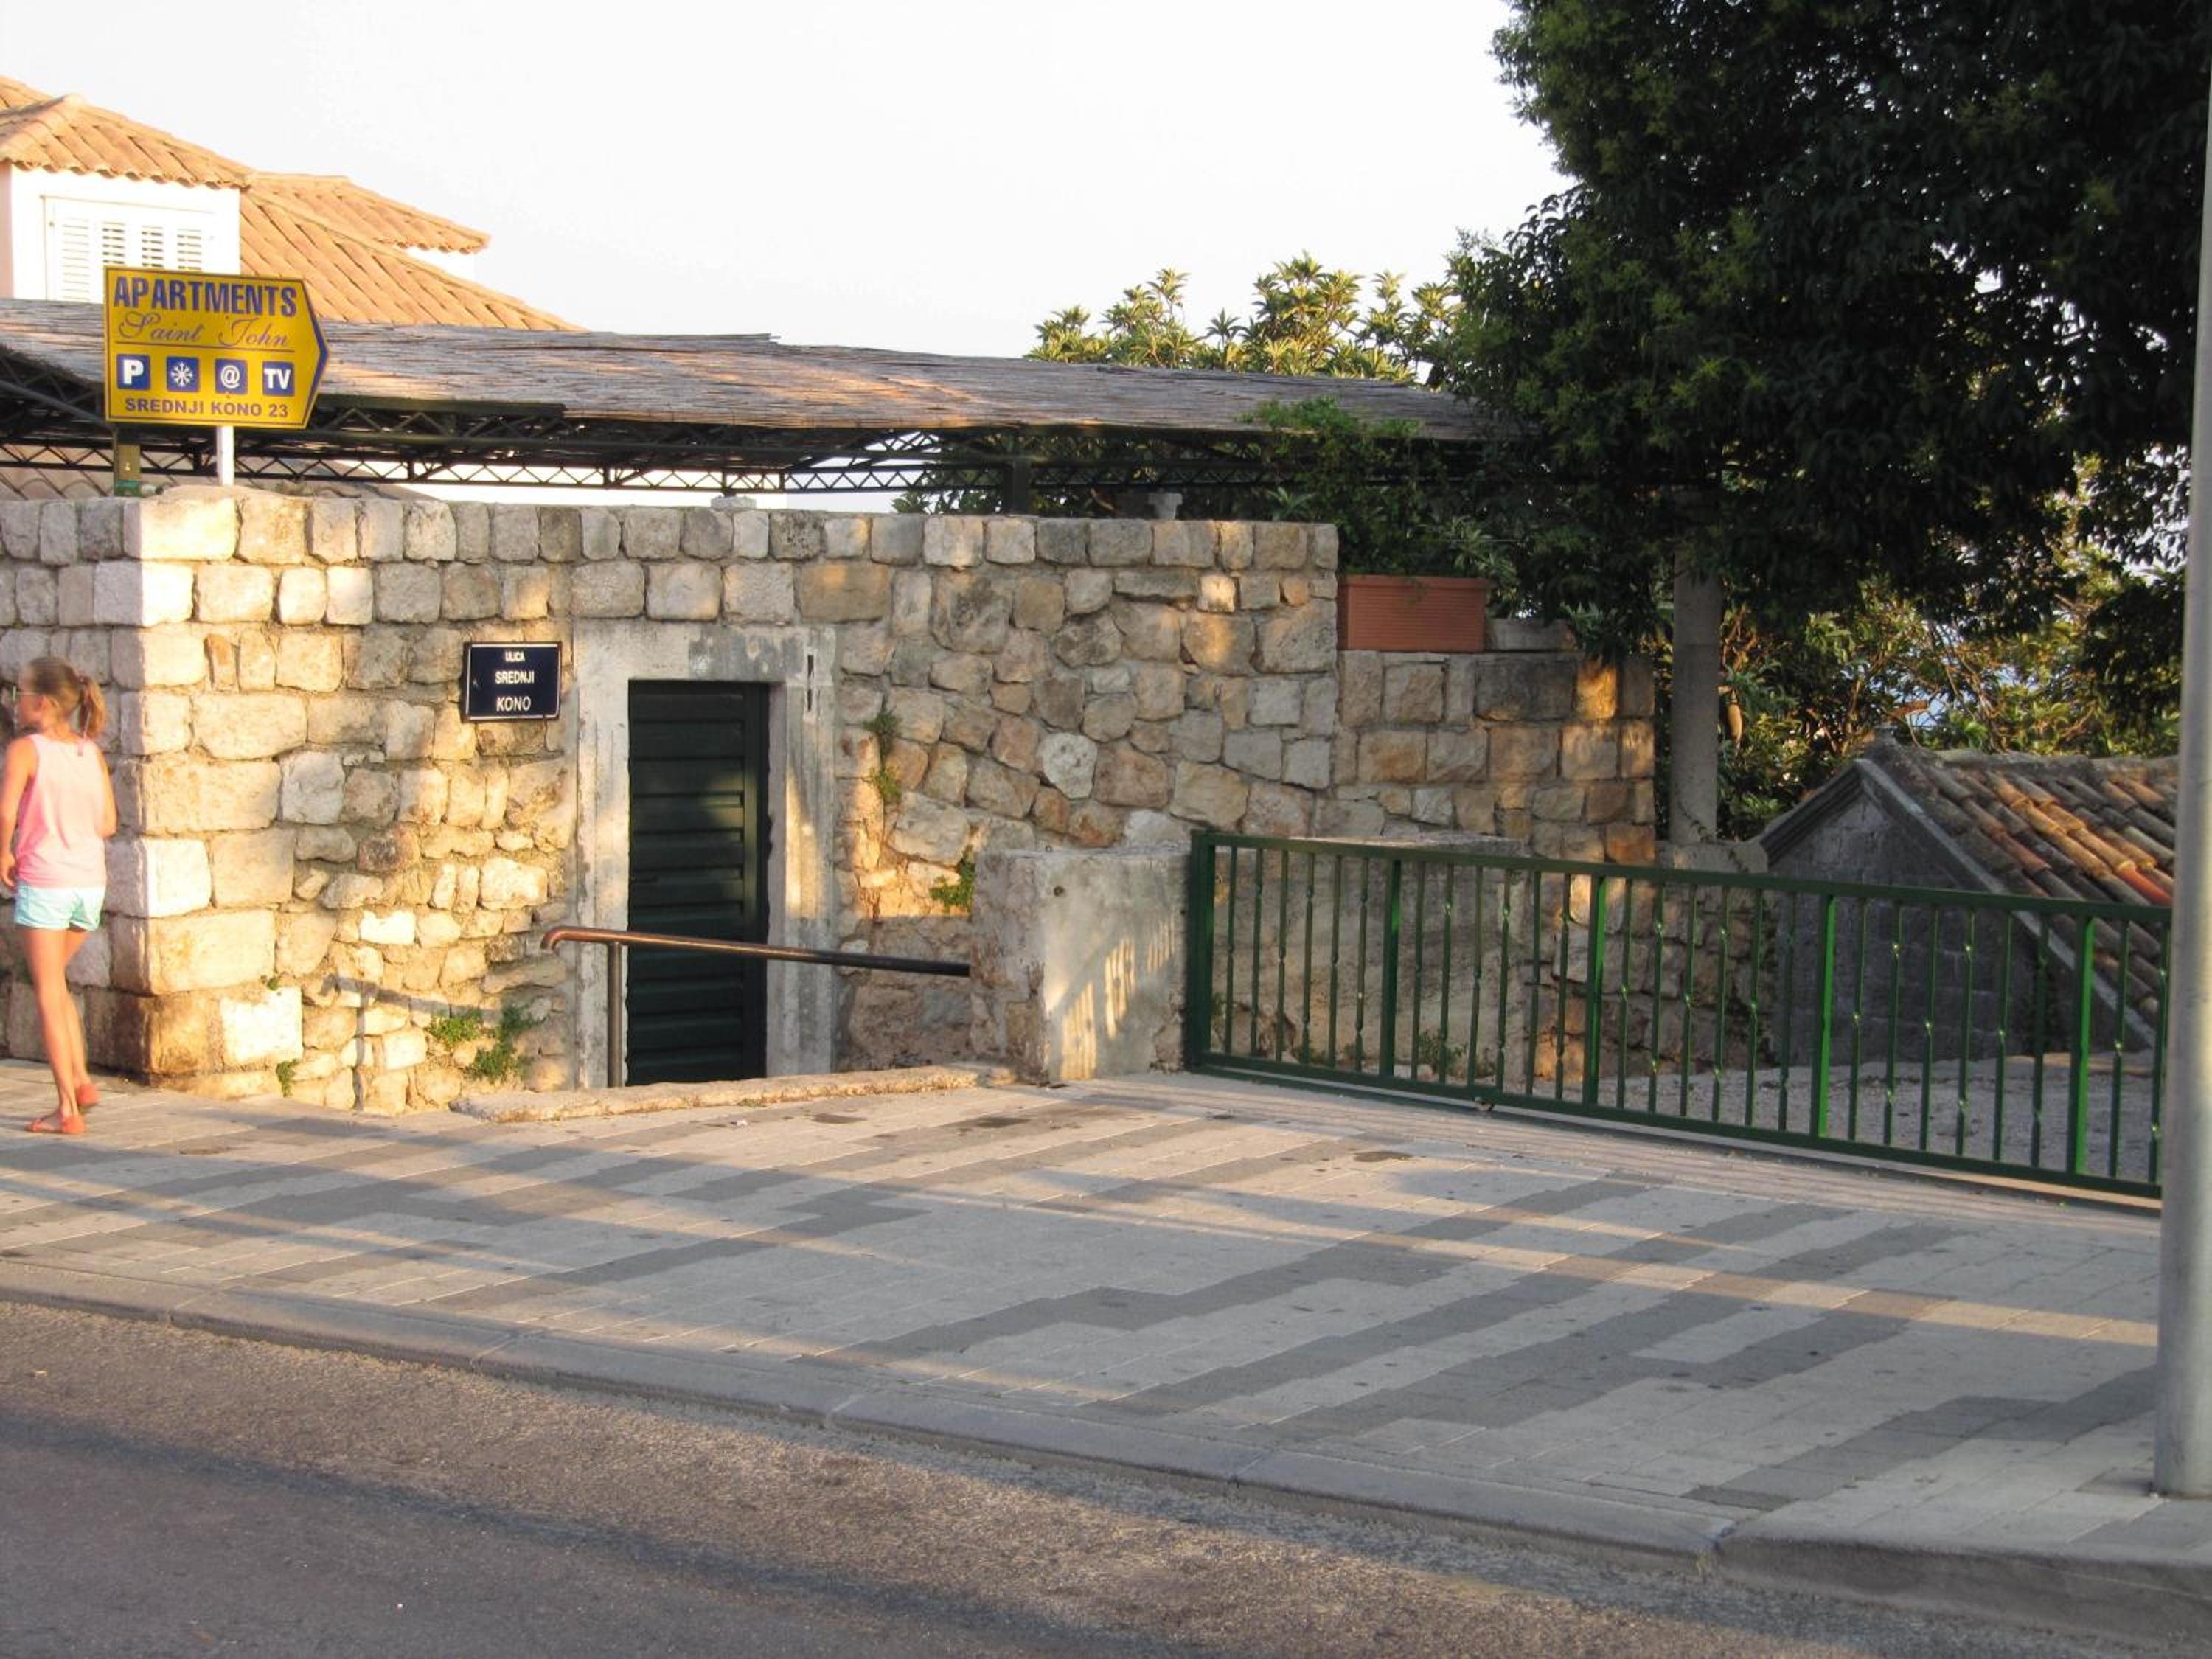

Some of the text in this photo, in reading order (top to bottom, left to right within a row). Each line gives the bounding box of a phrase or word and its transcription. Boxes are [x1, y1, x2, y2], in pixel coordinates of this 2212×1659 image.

[114, 276, 296, 317] APARTMENTS
[119, 310, 288, 347] Saint John
[123, 359, 144, 385] P
[263, 368, 291, 390] TV
[125, 397, 288, 417] SREDNJI KONO 23
[495, 670, 535, 684] SREDNJI
[496, 695, 532, 712] KONO
